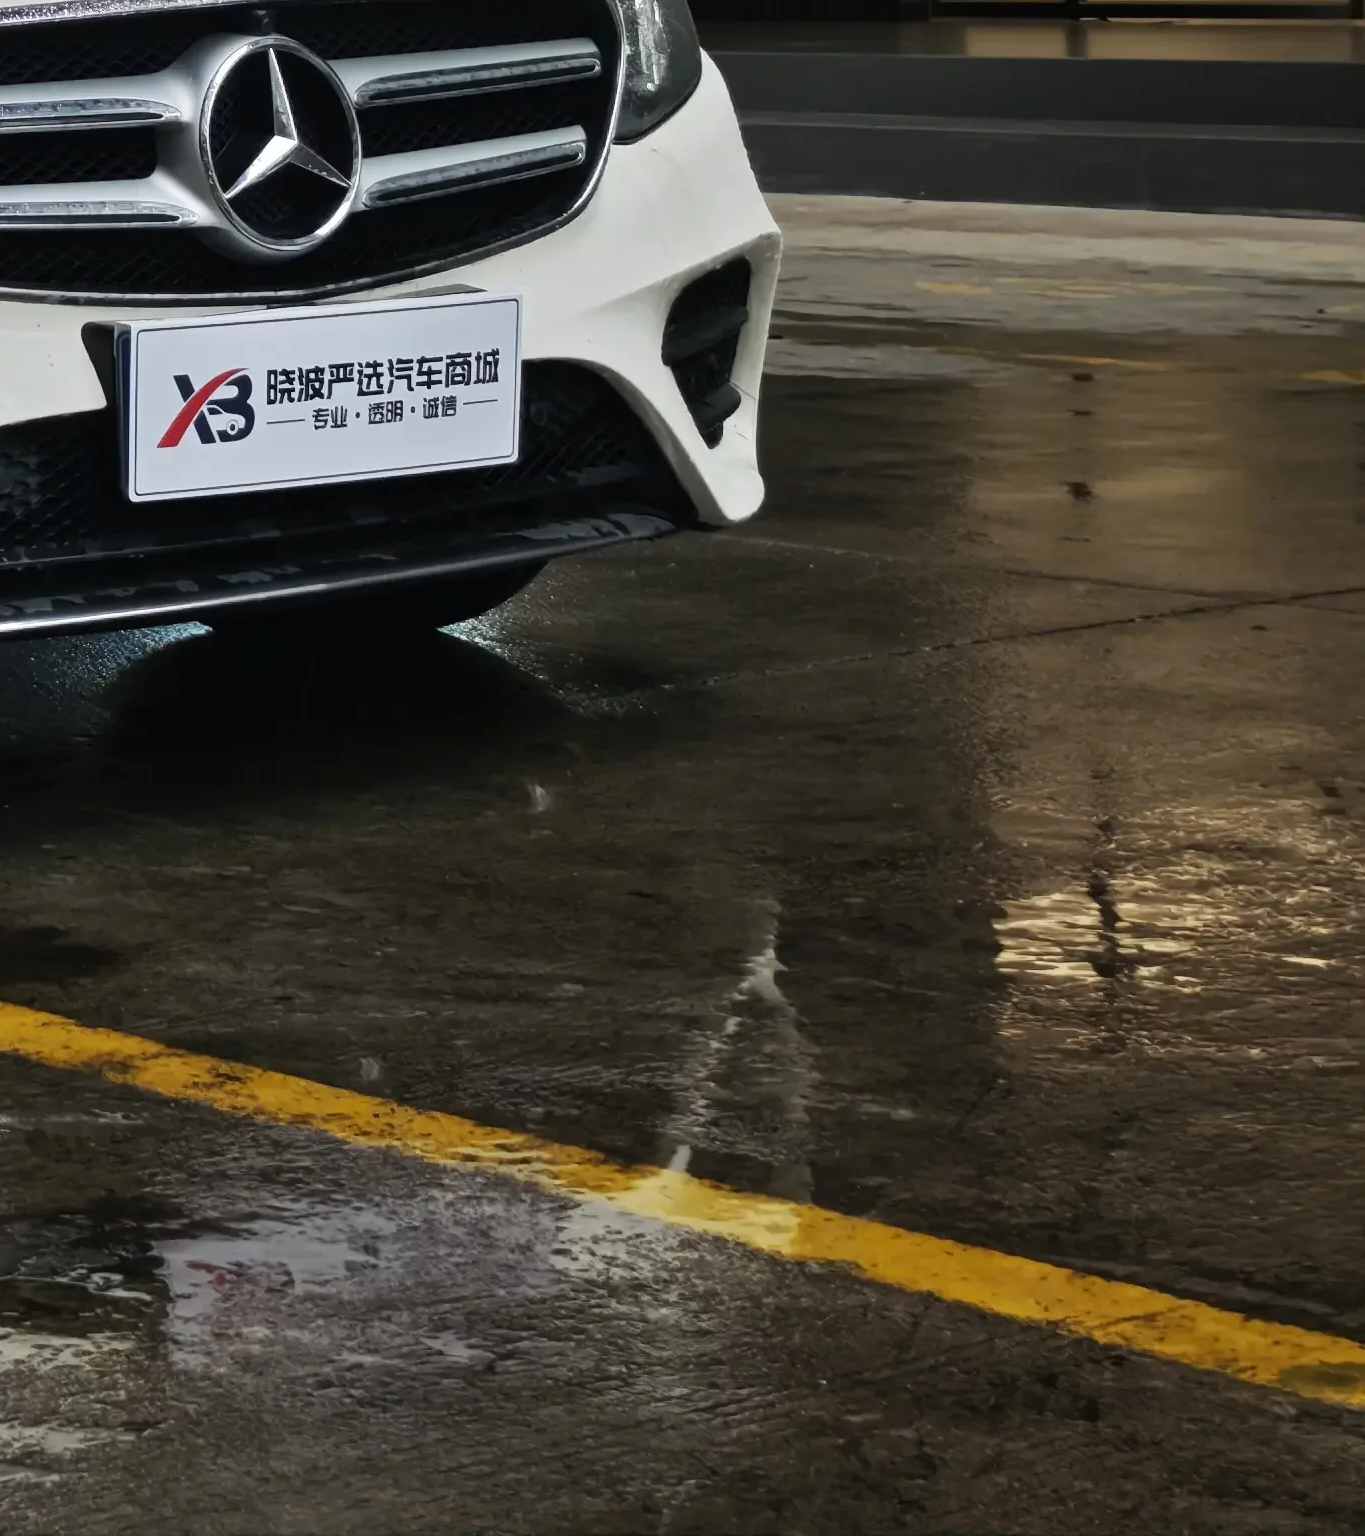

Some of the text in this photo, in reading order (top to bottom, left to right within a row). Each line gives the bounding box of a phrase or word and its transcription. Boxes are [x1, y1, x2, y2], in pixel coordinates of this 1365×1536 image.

[266, 348, 500, 405] 晓波严选汽车商城
